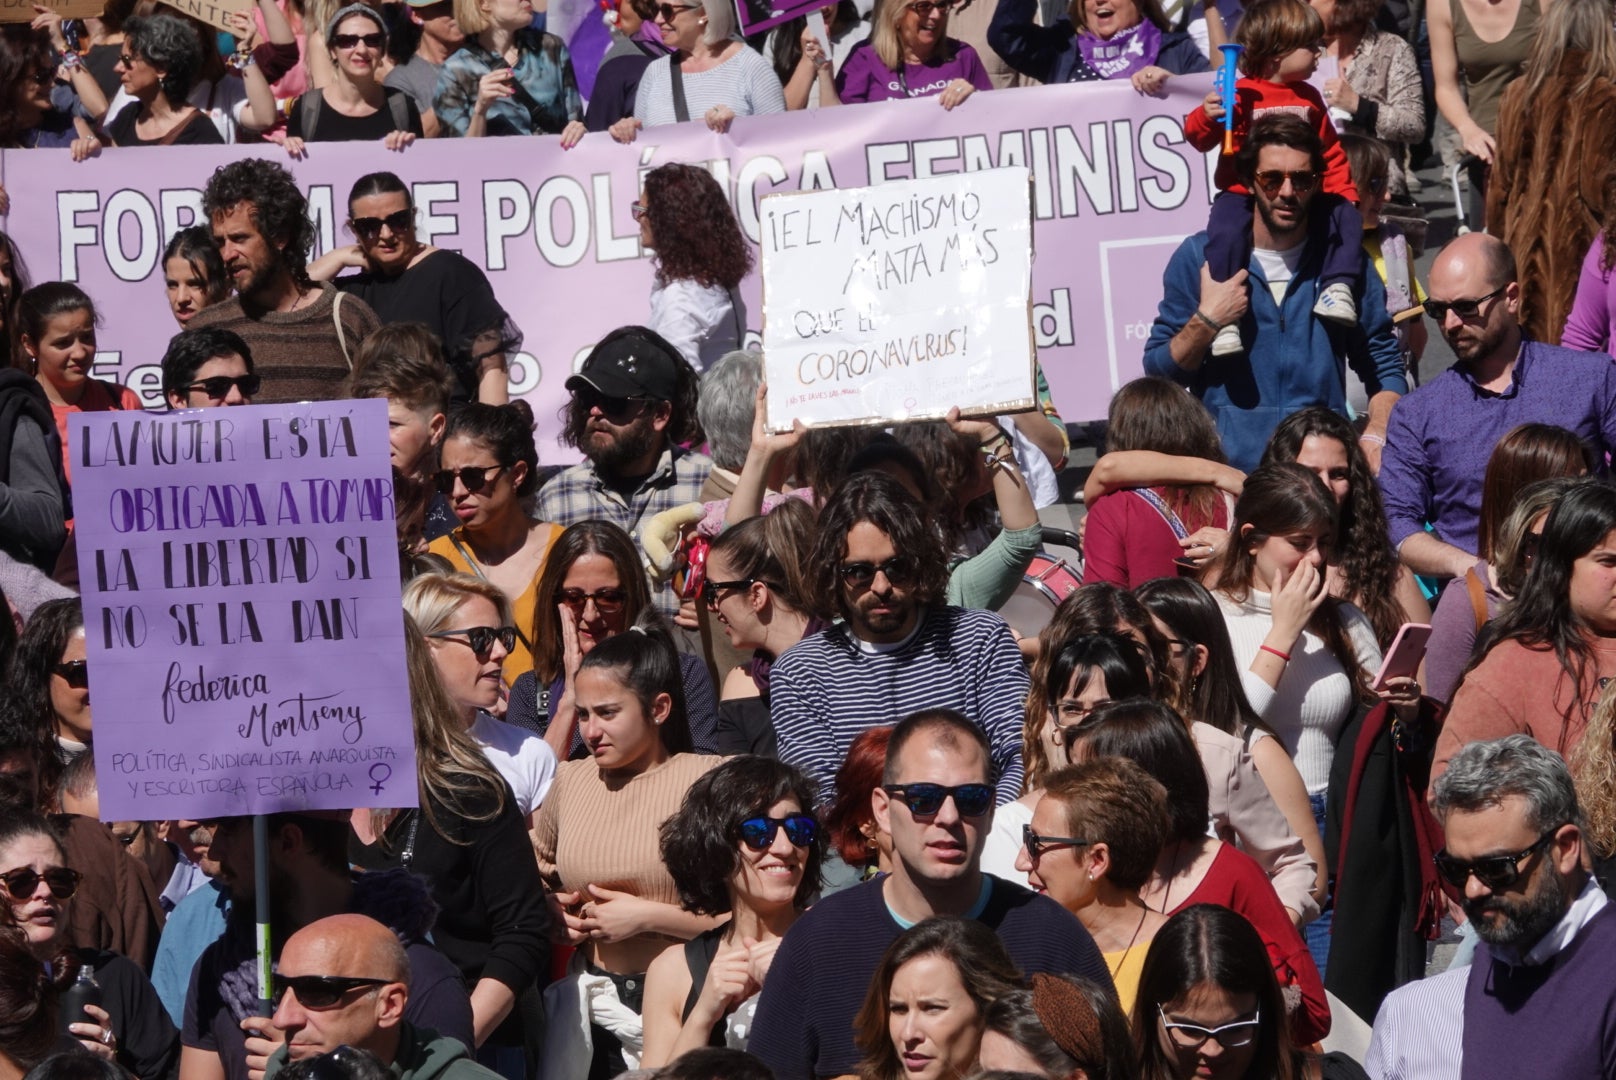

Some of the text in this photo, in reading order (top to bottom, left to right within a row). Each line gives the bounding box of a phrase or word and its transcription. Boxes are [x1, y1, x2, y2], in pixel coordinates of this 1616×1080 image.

[842, 242, 932, 296] MATA
[793, 307, 846, 339] QUE
[82, 409, 358, 467] LA MUJER ESTÁ
[109, 478, 395, 533] OBLIGADA A TOMAR
[95, 535, 373, 592] LA LIBERTAD SI
[102, 597, 361, 649] NO SE LA DAN
[236, 689, 367, 747] Montseny
[128, 772, 353, 798] Y ESCRITORA ESPAÑOLA
